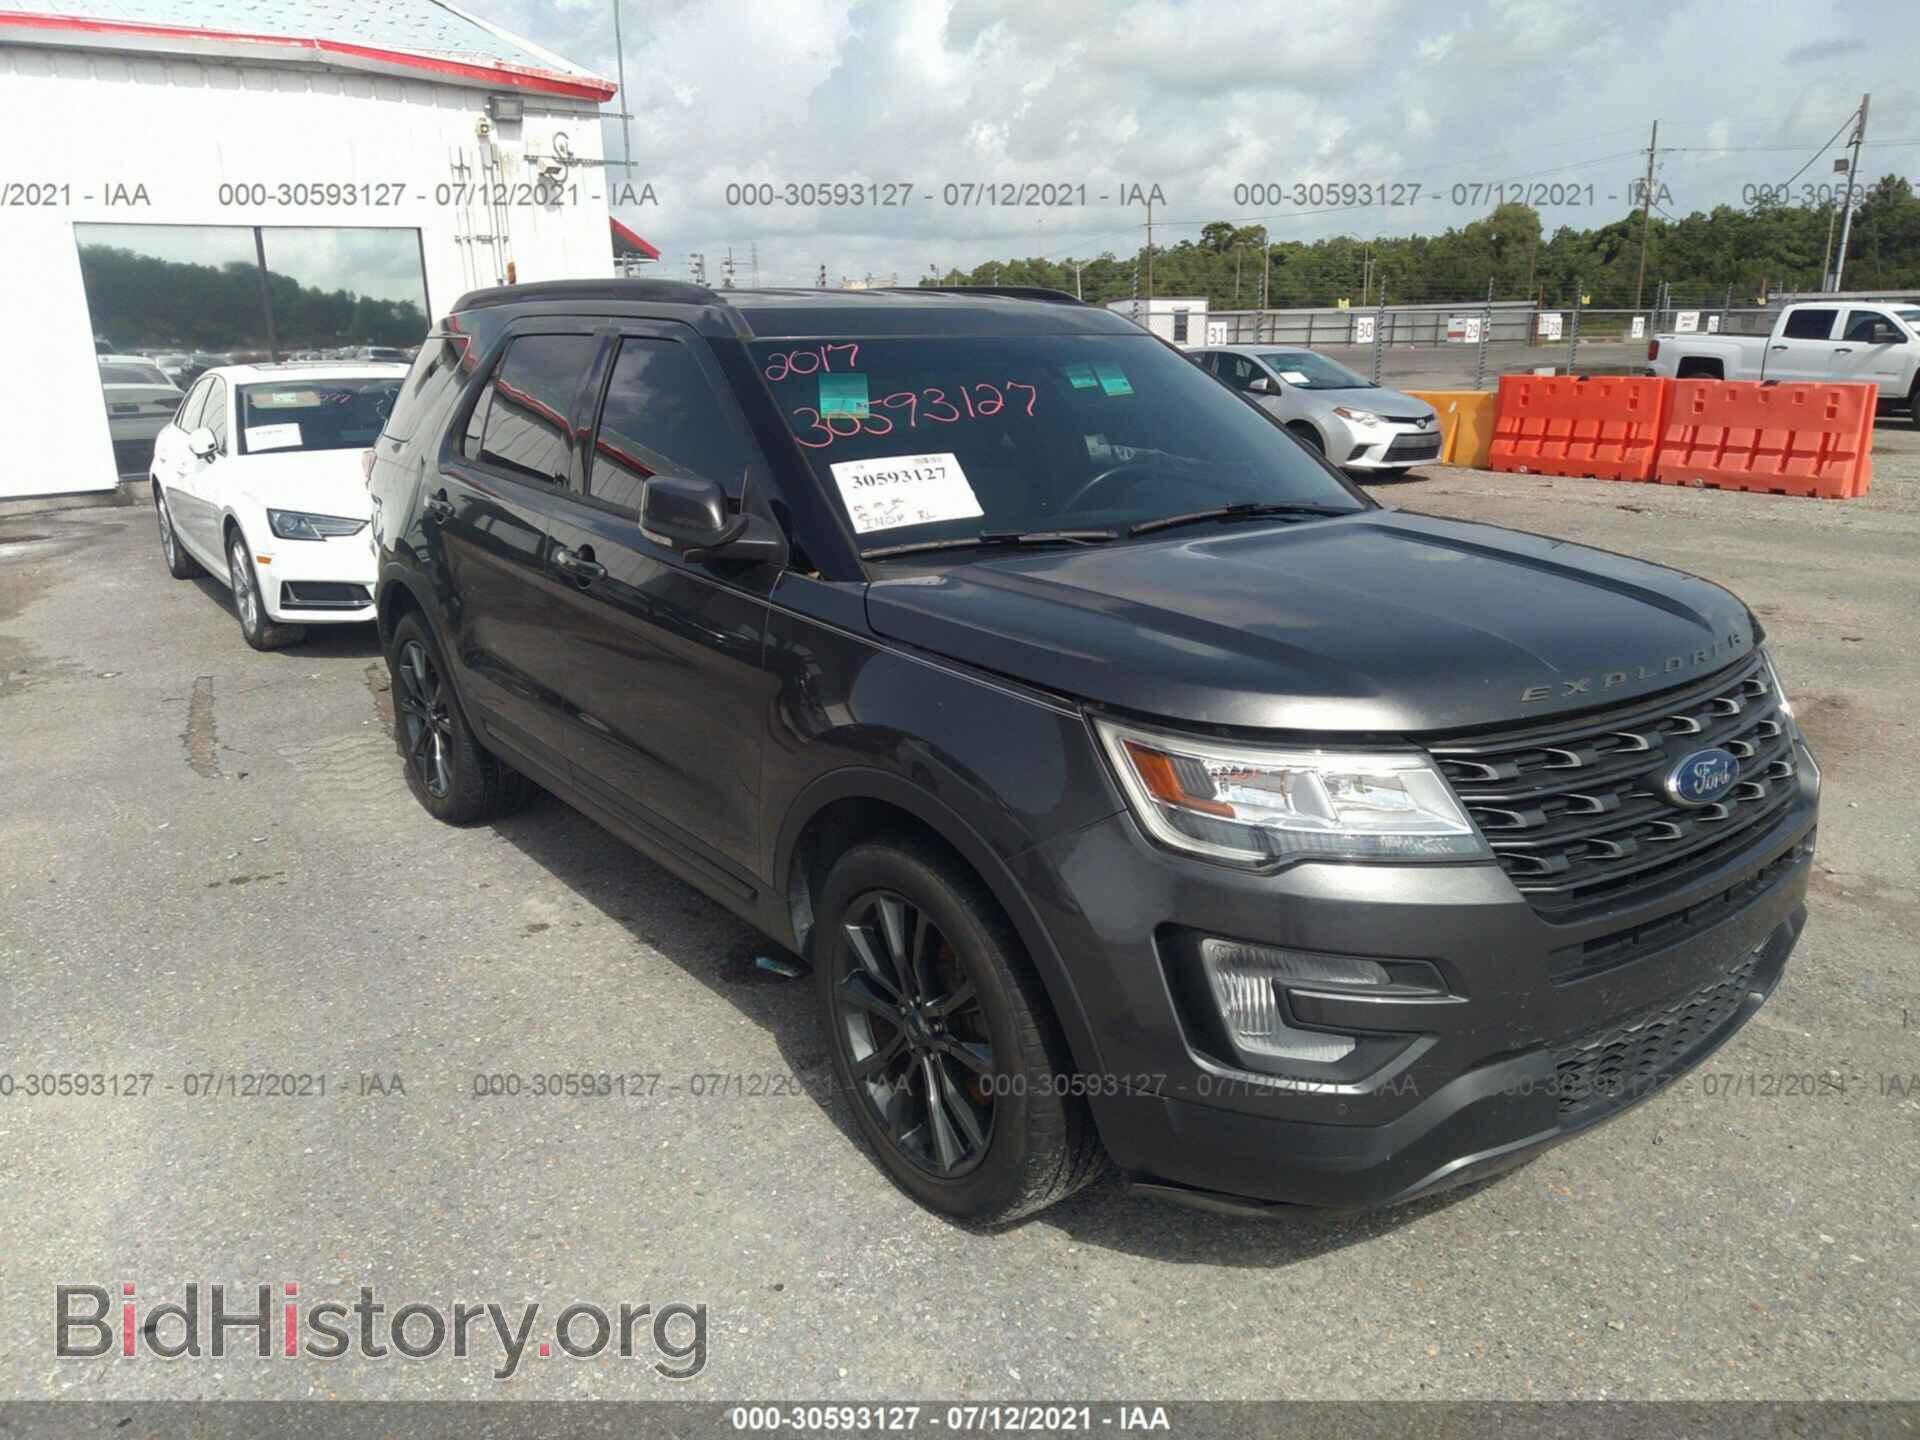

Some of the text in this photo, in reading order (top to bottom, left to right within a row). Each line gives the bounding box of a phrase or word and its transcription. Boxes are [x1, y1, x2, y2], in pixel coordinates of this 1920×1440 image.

[1210, 327, 1225, 344] 31
[1357, 322, 1373, 338] 30
[1467, 323, 1479, 338] 29
[765, 344, 858, 380] 2017
[793, 381, 1036, 447] 30593127
[852, 466, 945, 489] 30593127
[1693, 757, 1731, 794] Ford
